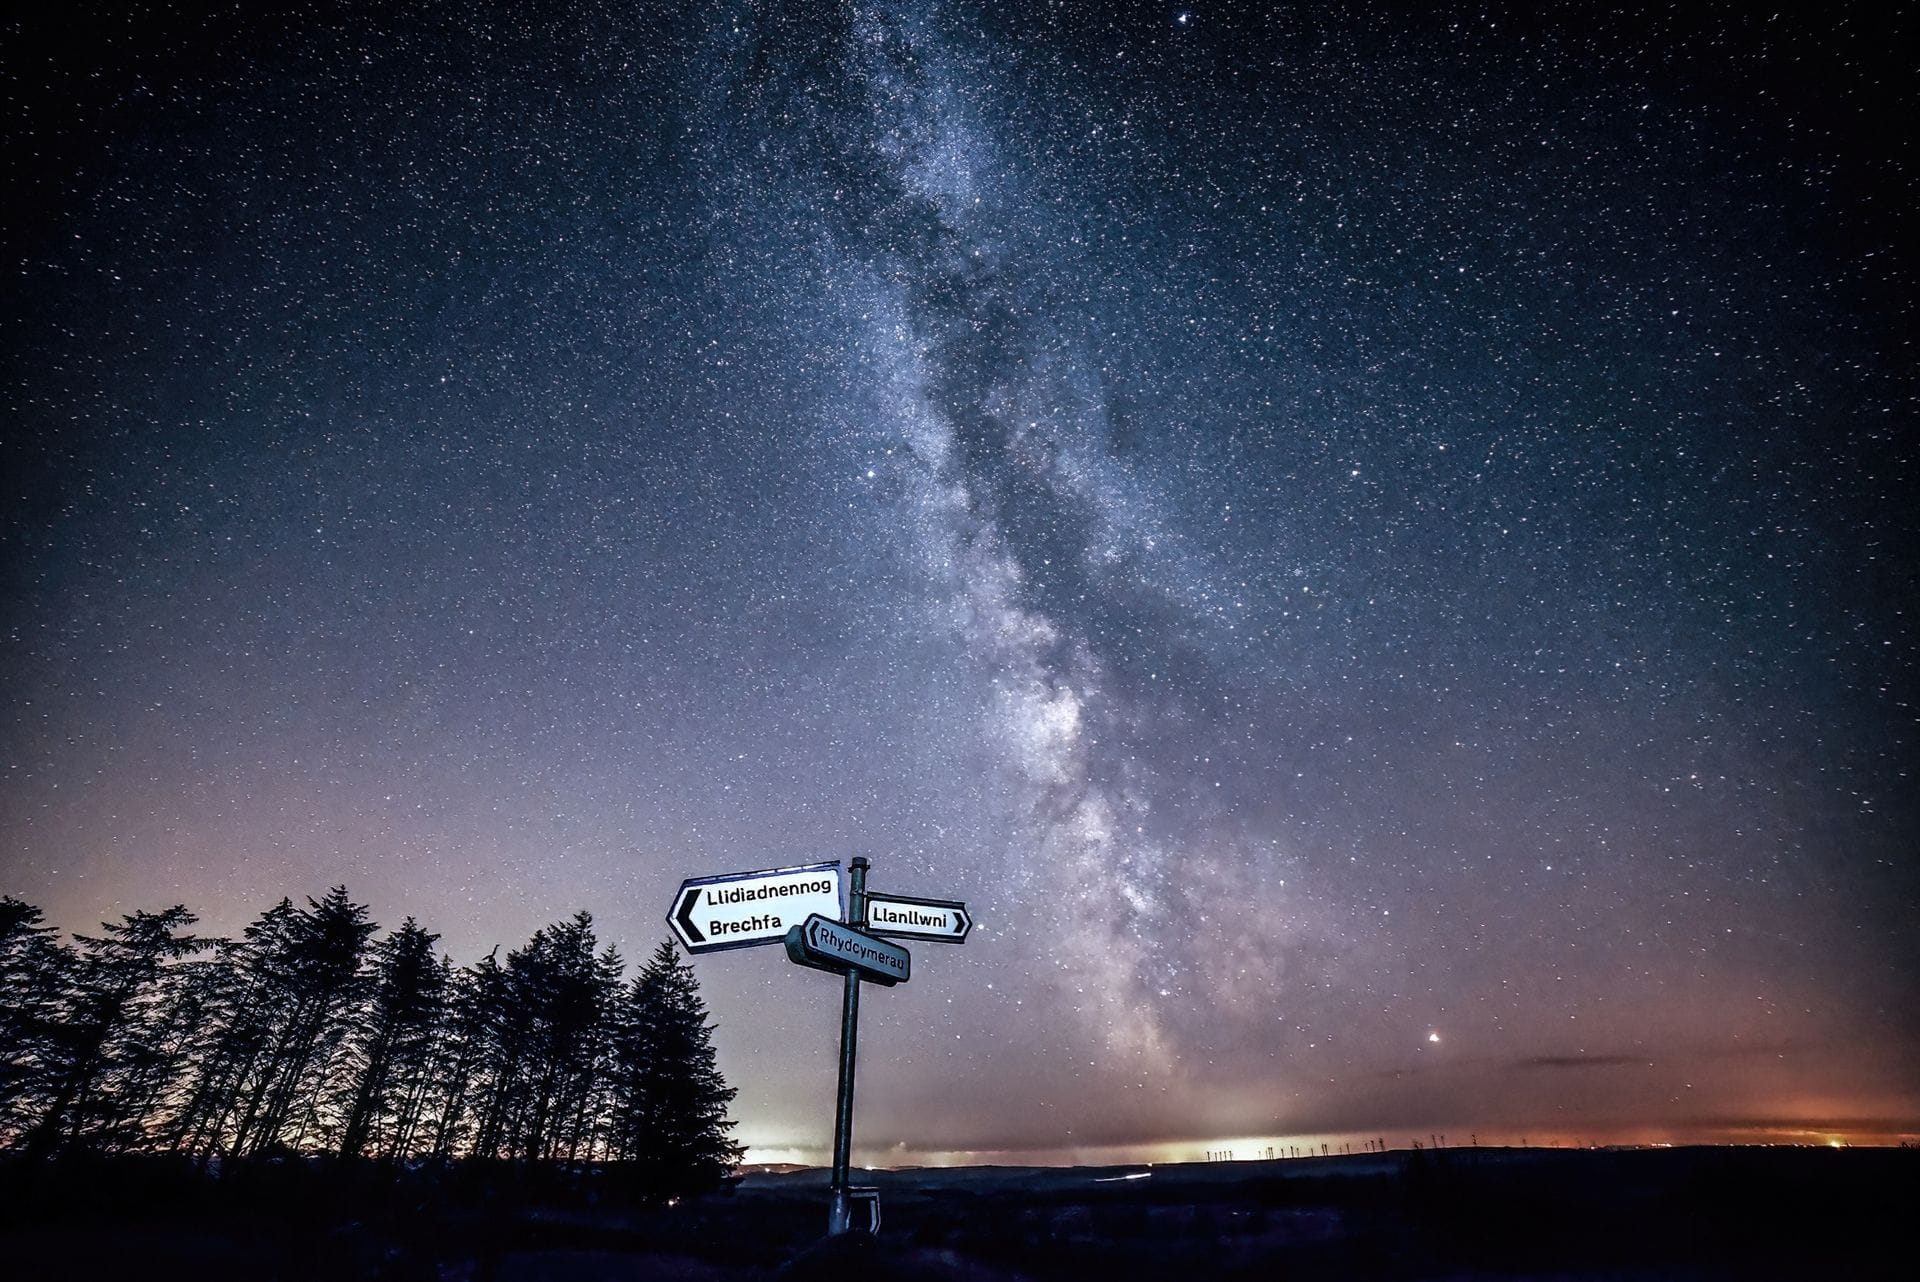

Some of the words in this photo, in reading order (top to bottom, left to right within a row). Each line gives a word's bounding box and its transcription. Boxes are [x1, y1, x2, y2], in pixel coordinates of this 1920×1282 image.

[707, 880, 831, 905] Llidiadnennog
[710, 915, 782, 935] Brechfa
[873, 907, 947, 928] Llanllwni
[820, 928, 904, 970] Rhydcymerau
